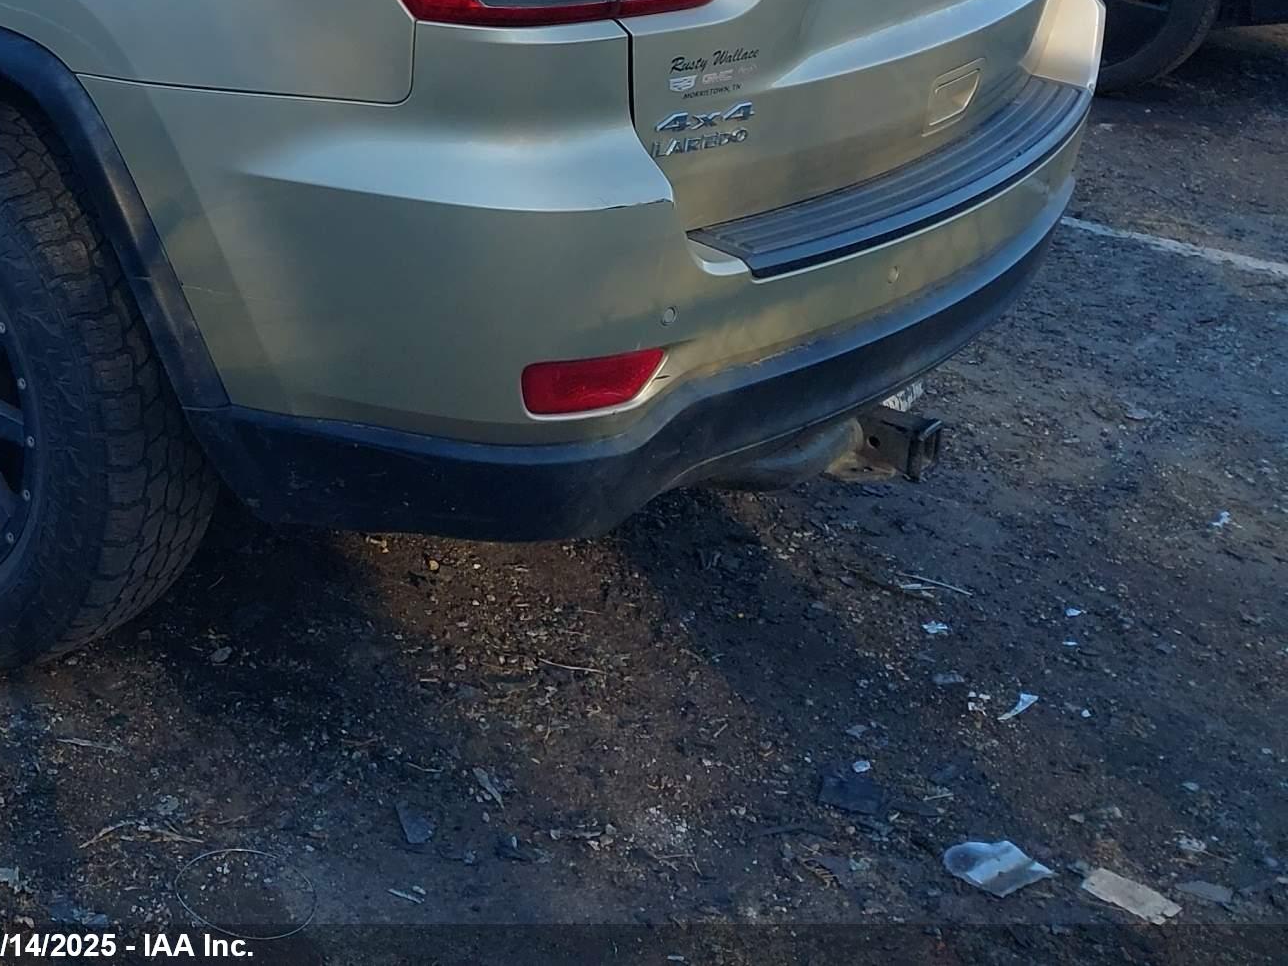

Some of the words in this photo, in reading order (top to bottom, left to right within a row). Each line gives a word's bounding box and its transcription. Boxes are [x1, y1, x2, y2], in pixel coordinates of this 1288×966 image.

[670, 56, 708, 73] Rusty
[712, 48, 760, 66] Wallace
[651, 127, 747, 158] LAREDO
